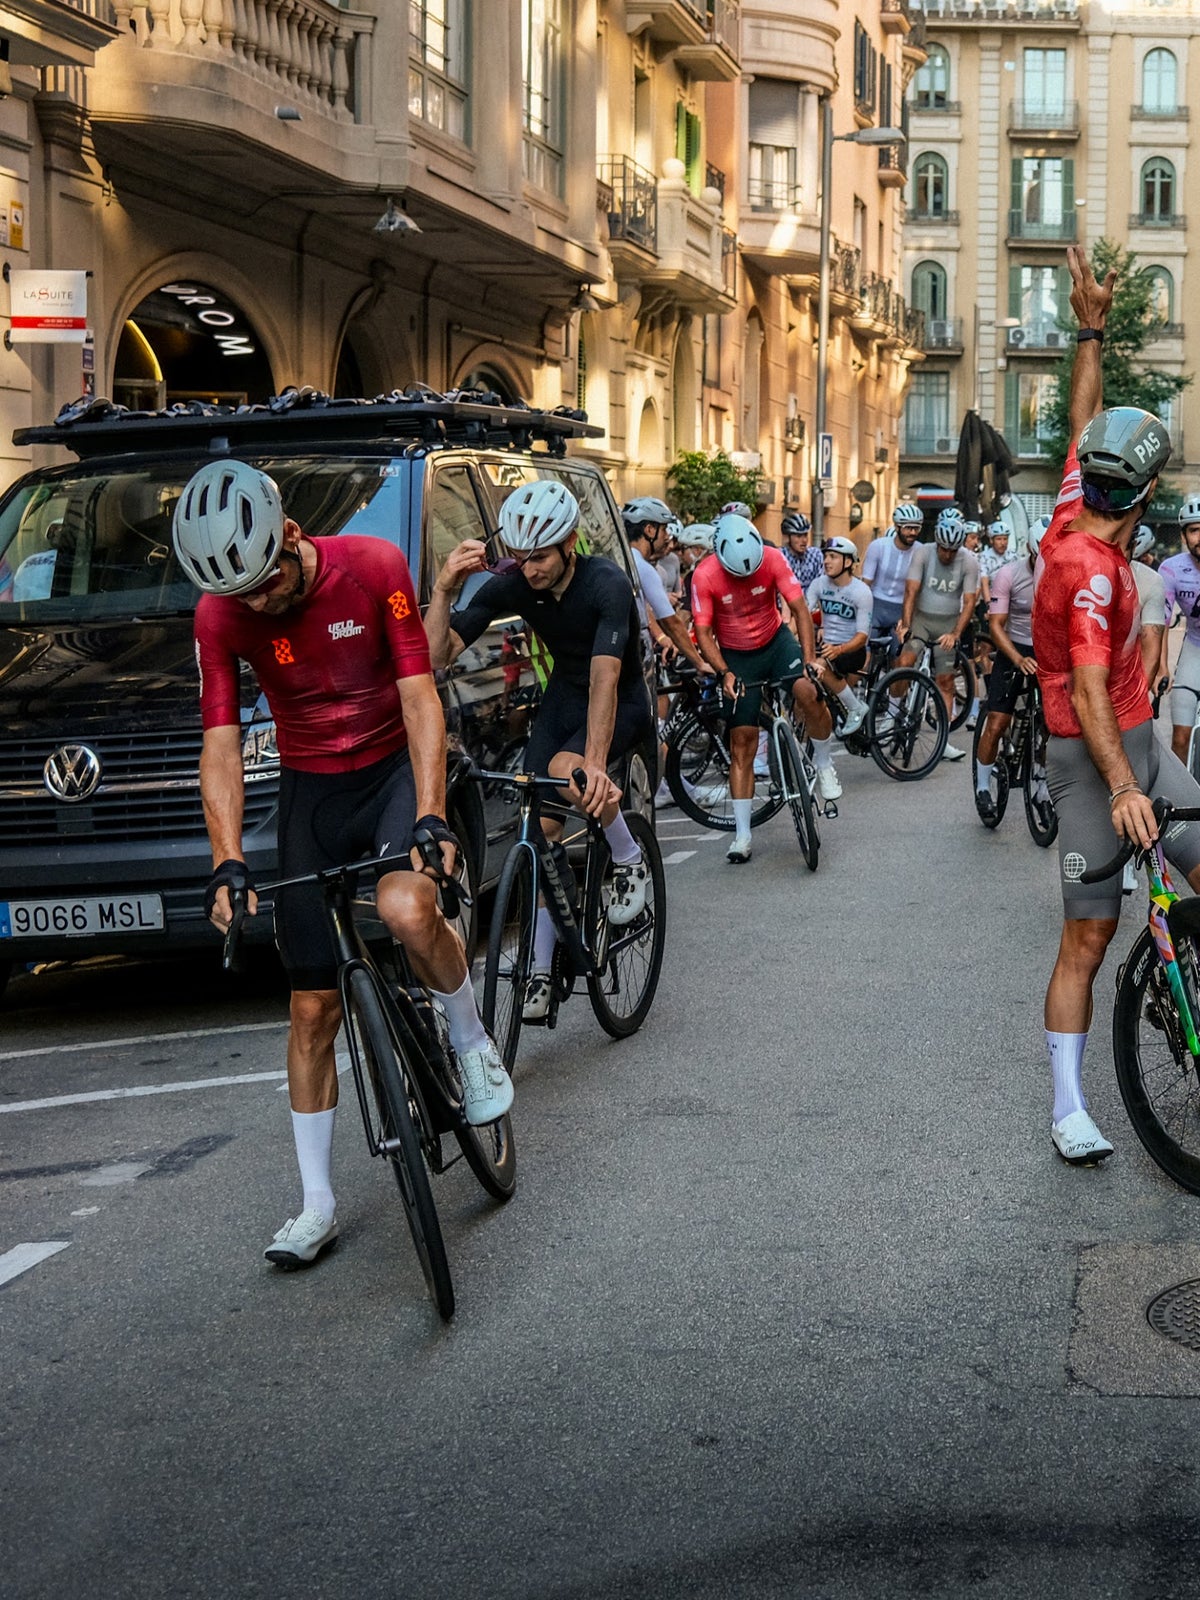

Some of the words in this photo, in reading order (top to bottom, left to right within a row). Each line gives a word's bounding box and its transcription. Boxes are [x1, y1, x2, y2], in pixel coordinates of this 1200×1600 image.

[823, 439, 831, 475] P
[1133, 431, 1161, 464] PAS
[928, 576, 957, 592] PAS
[328, 619, 354, 634] VELO
[540, 851, 578, 930] GIANT
[14, 904, 88, 932] 9066
[98, 901, 155, 929] MSL
